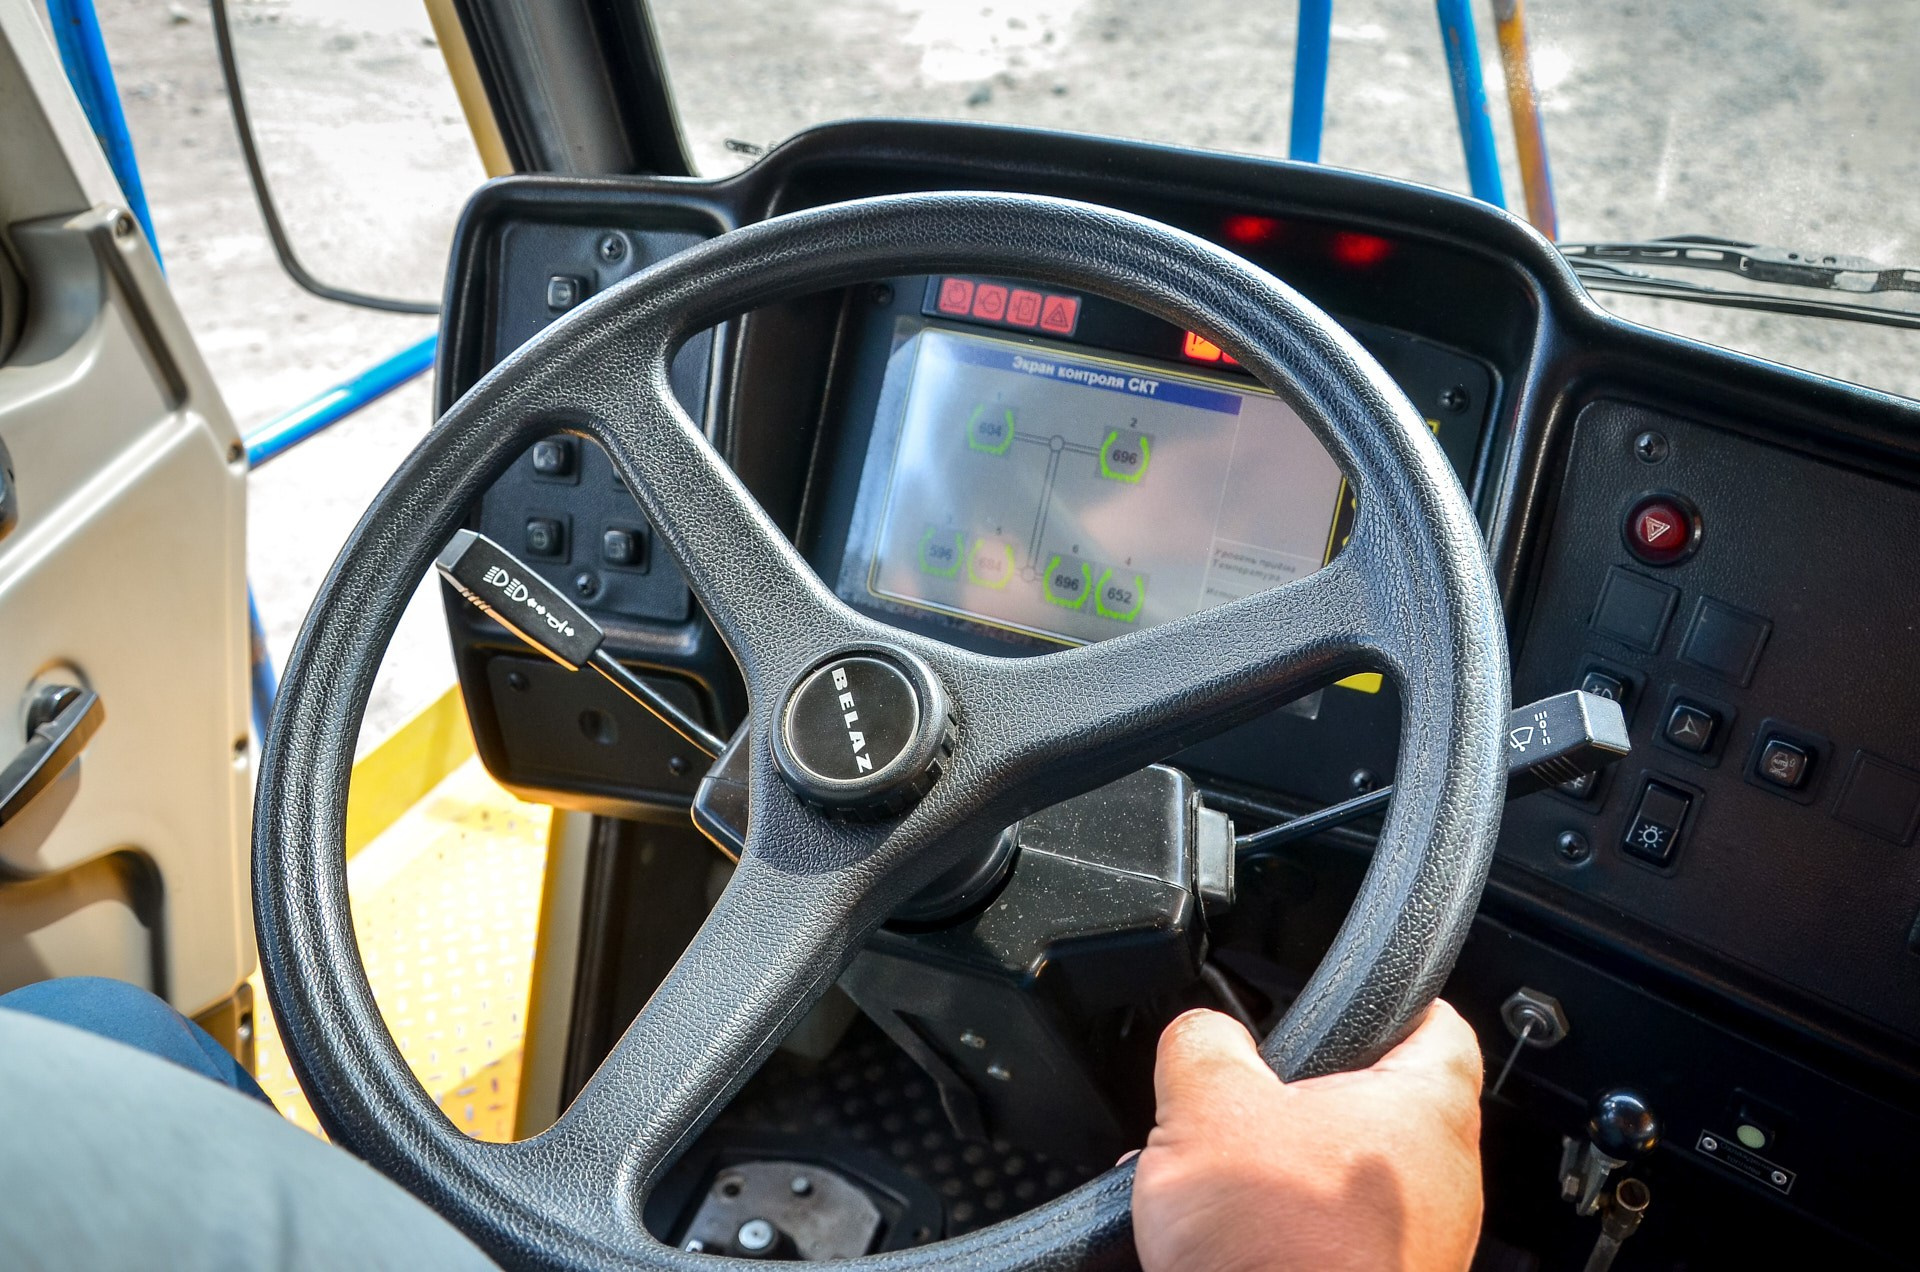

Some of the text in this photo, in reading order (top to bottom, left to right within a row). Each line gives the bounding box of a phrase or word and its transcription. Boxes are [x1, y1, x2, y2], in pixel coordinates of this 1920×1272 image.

[1012, 355, 1159, 395] Экран контроля СКТ
[1130, 417, 1138, 428] 2
[1112, 449, 1138, 465] 696
[1054, 574, 1080, 592] 696
[1107, 587, 1133, 605] 652
[831, 667, 873, 774] BELAZ
